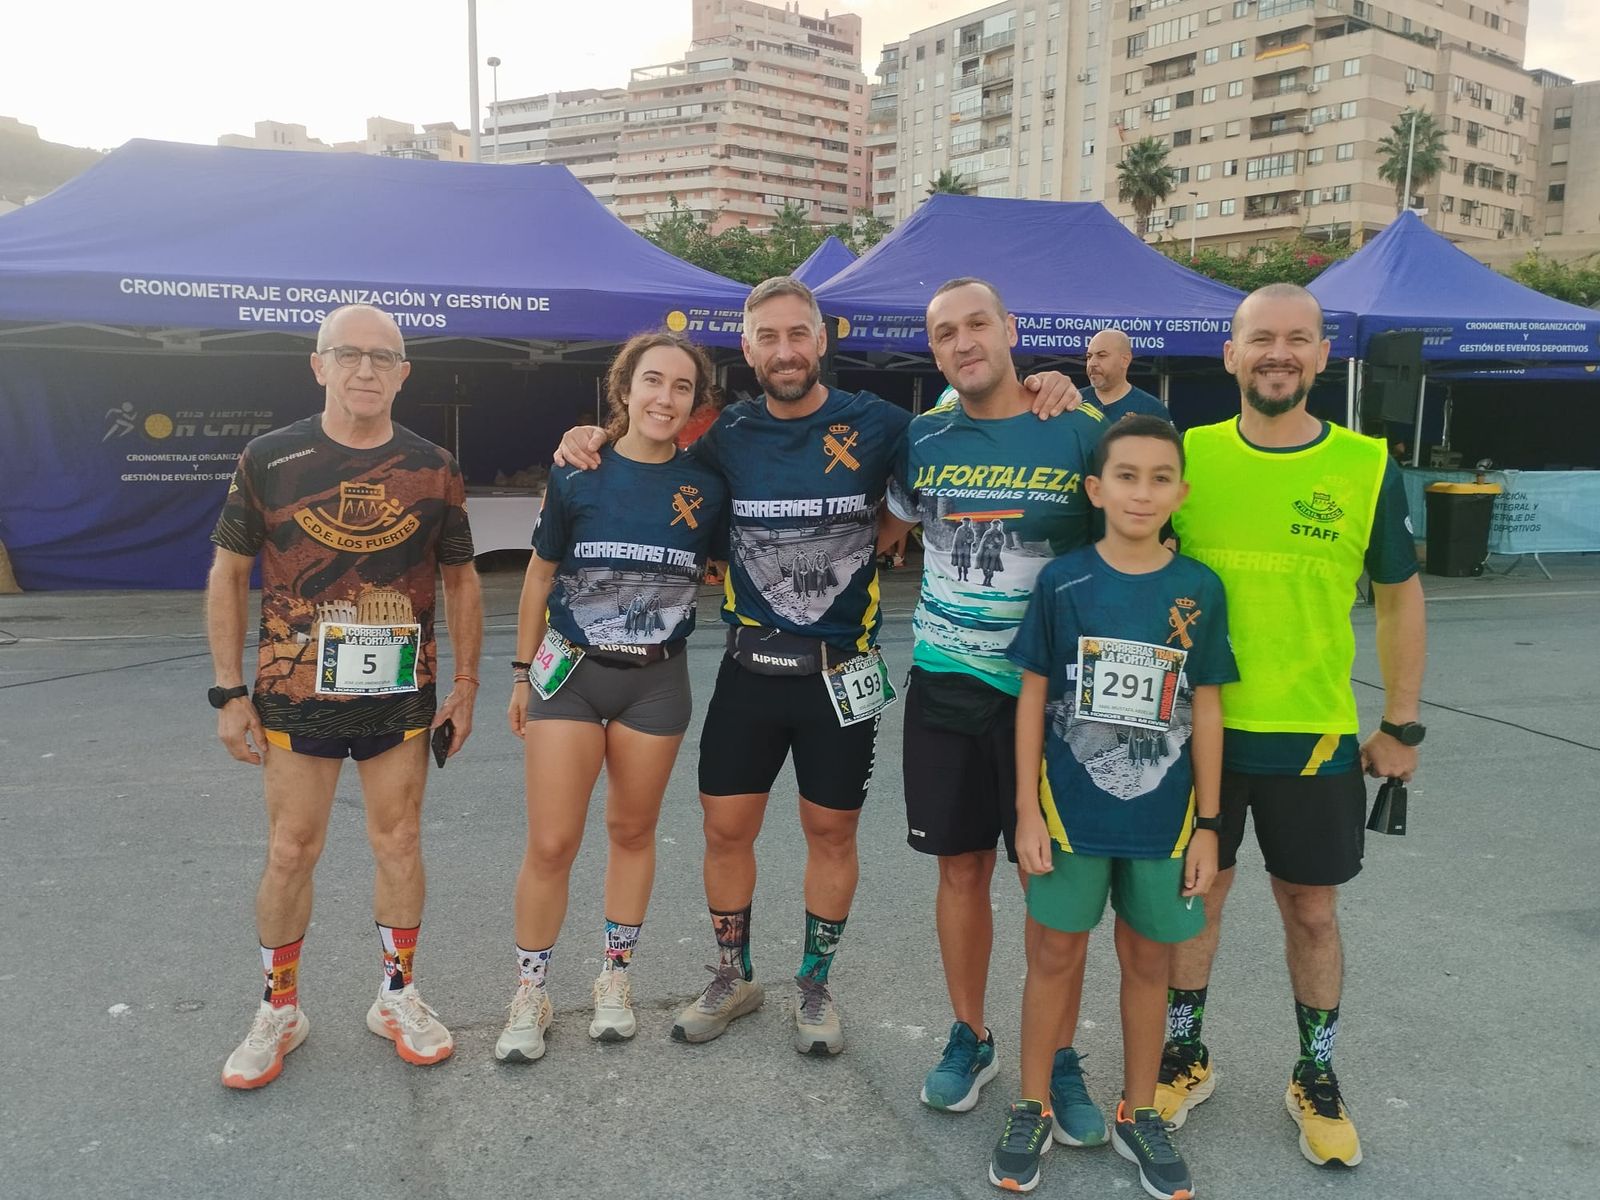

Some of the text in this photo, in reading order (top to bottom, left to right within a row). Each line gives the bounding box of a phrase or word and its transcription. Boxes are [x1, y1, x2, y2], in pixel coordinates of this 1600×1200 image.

[120, 278, 550, 311] CRONOMETRAJE ORGANIZACIÓN Y GESTIÓN DE
[239, 306, 326, 323] EVENTOS
[1055, 317, 1151, 331] ORGANIZACIÓN
[1154, 319, 1162, 331] Y
[1166, 318, 1219, 332] GESTIÓN
[1465, 321, 1586, 331] CRONOMETRAJE ORGANIZACIÓN
[1021, 334, 1081, 347] EVENTOS
[1523, 333, 1529, 341] Y
[1459, 343, 1589, 353] GESTIÓN DE EVENTOS DEPORTIVOS
[126, 454, 197, 462] CRONOMETRAJE
[193, 464, 199, 472] Y
[121, 472, 160, 482] GESTIÓN
[161, 473, 173, 481] DE
[174, 473, 214, 481] EVENTOS
[913, 465, 1081, 493] LA FORTALEZA
[936, 486, 1024, 500] CORRERÍAS
[1026, 491, 1069, 505] TRAIL
[826, 493, 867, 515] TRAIL
[1524, 513, 1536, 521] DE
[303, 515, 415, 549] C.D.E. LOS FUERTES
[1290, 523, 1340, 542] STAFF
[1493, 524, 1541, 532] DEPORTIVOS
[667, 549, 697, 568] TRAIL
[345, 636, 409, 646] LA FORTALEZA
[599, 644, 647, 656] KIPRUN
[362, 653, 377, 675] 5
[752, 653, 798, 667] KIPRUN
[1101, 651, 1172, 671] LA FORTALEZA
[852, 672, 881, 700] 193
[1102, 671, 1154, 702] 291
